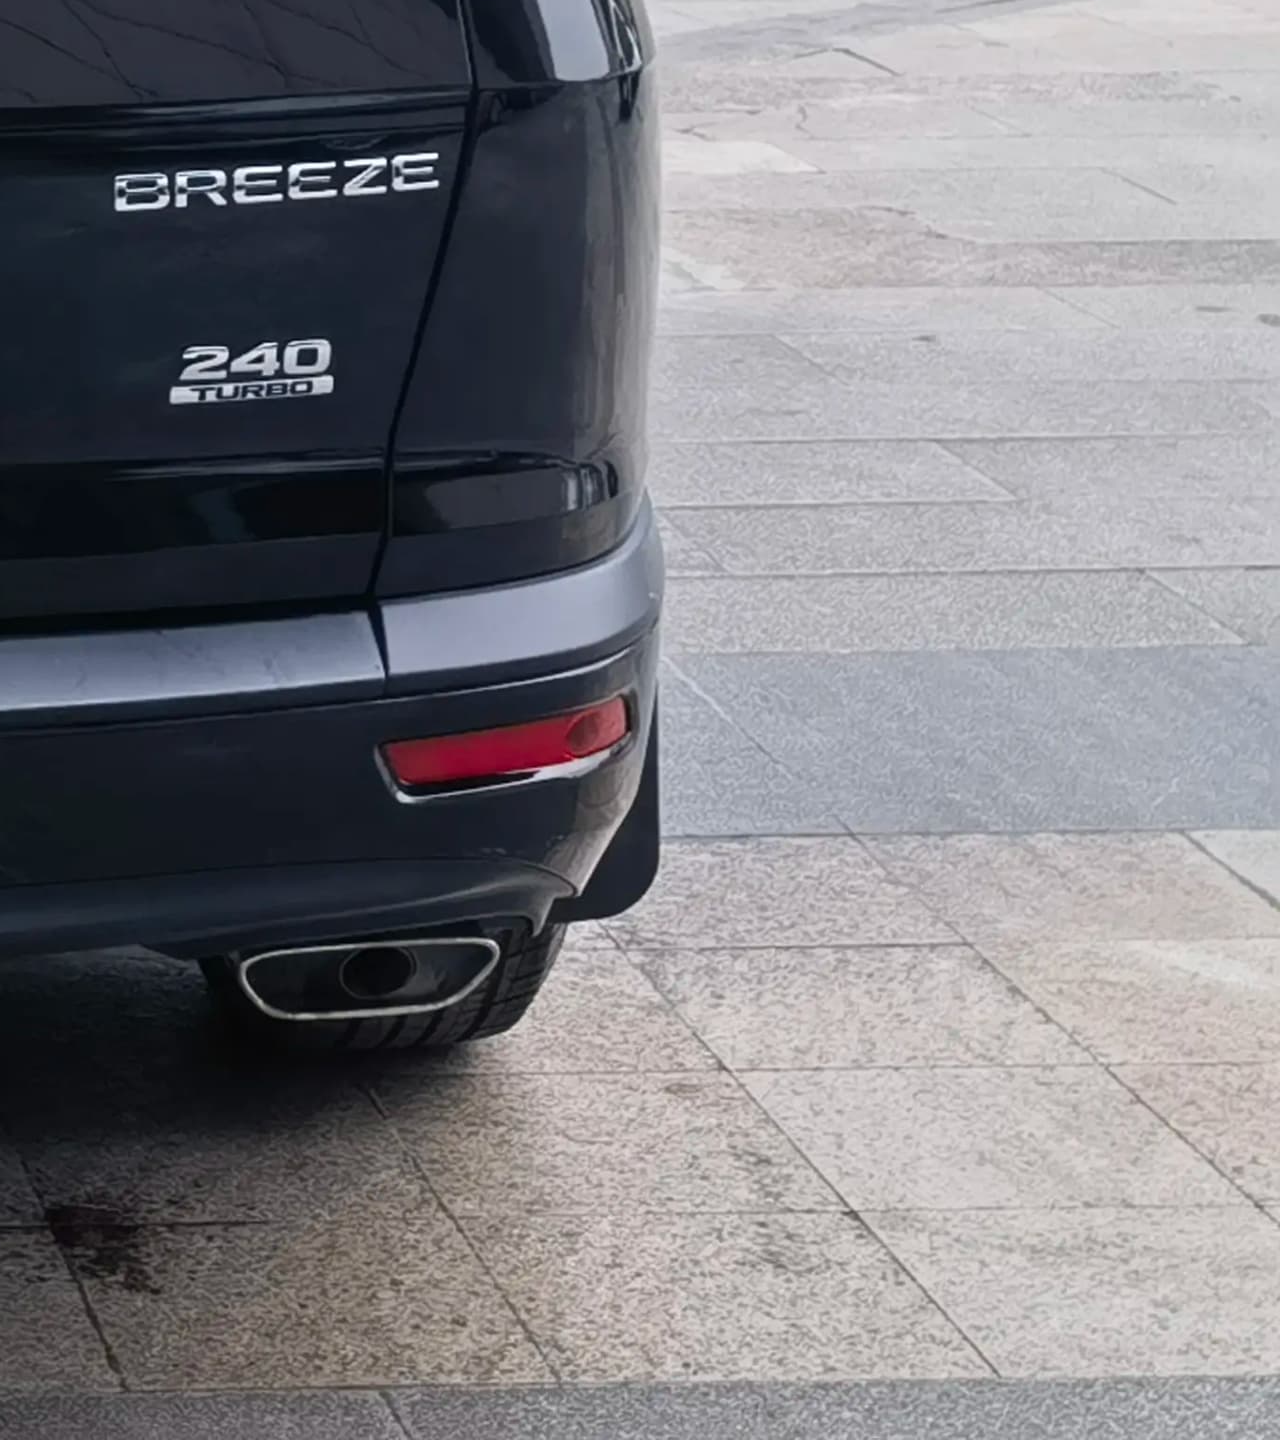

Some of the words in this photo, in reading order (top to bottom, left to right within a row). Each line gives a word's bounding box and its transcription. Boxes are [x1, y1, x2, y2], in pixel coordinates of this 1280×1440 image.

[114, 152, 440, 212] BREEZE
[179, 338, 333, 380] 240
[190, 381, 314, 401] TURBO
